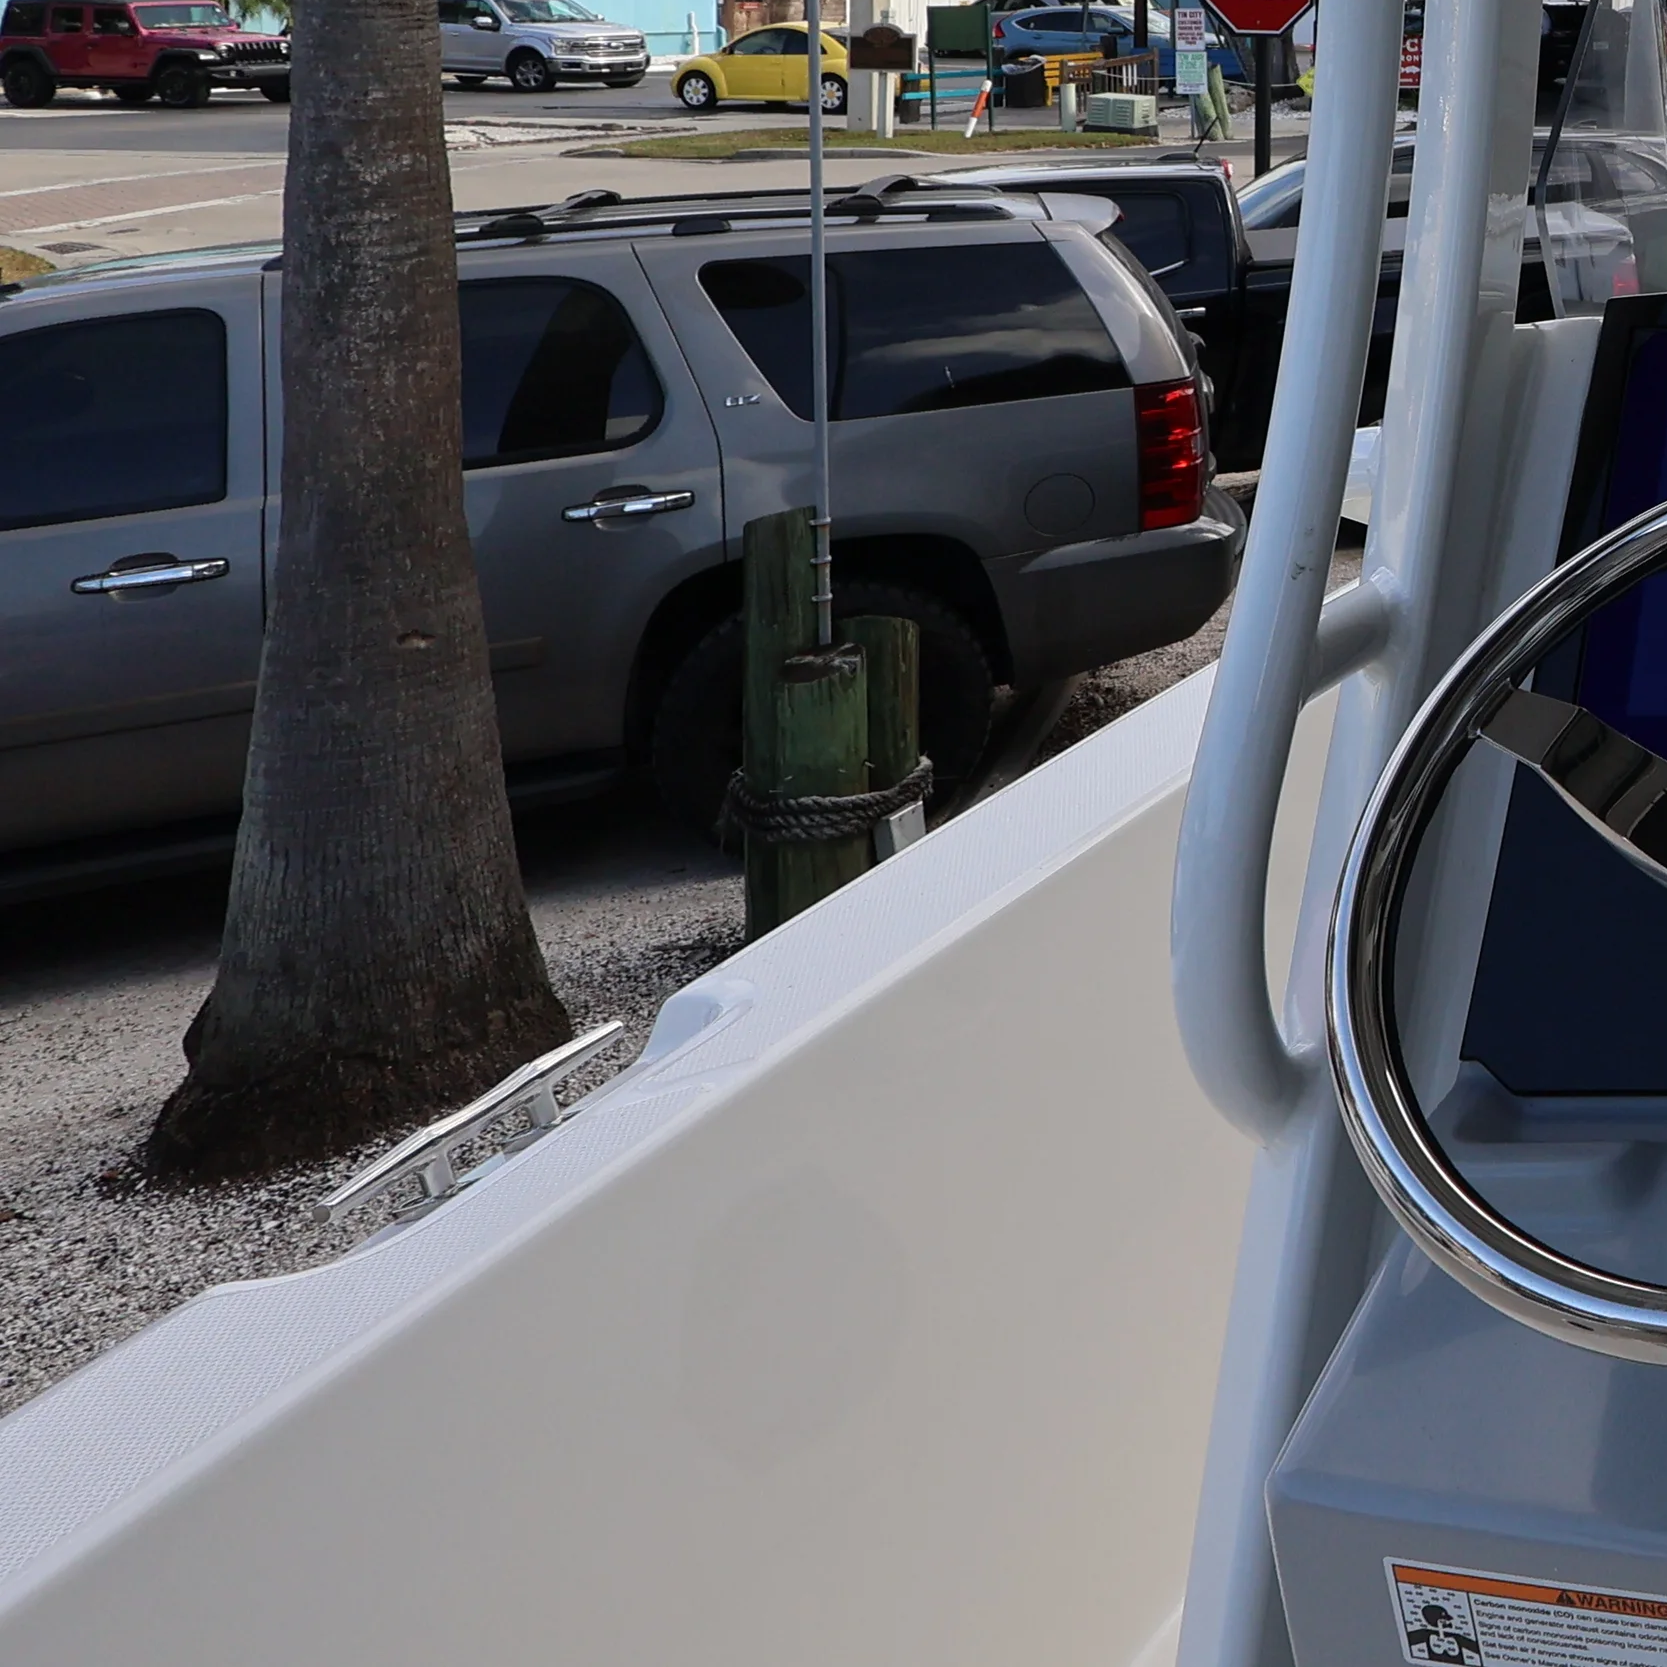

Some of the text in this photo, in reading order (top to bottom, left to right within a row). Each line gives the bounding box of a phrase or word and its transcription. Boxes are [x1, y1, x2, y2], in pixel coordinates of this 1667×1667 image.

[725, 393, 761, 407] LTZ
[1474, 1599, 1506, 1609] Carbon
[1508, 1604, 1551, 1615] monoxide
[1553, 1609, 1574, 1620] (CO)
[1594, 1616, 1619, 1625] cause
[1620, 1619, 1642, 1629] brain
[1476, 1610, 1505, 1620] Engine
[1507, 1615, 1522, 1623] and
[1524, 1618, 1564, 1629] generator
[1566, 1623, 1599, 1633] exhaust
[1600, 1628, 1636, 1638] contains
[1478, 1621, 1501, 1630] Signs
[1512, 1627, 1541, 1636] carbon
[1543, 1631, 1583, 1641] monoxide
[1585, 1636, 1626, 1649] poisoning
[1627, 1642, 1657, 1652] include
[1480, 1630, 1496, 1638] and
[1497, 1632, 1515, 1641] lack
[1482, 1640, 1497, 1648] Get
[1498, 1642, 1518, 1651] fresh
[1538, 1649, 1567, 1659] anyone
[1568, 1653, 1595, 1662] shows
[1596, 1656, 1618, 1666] signs
[1484, 1651, 1501, 1660] See
[1502, 1654, 1536, 1665] Owner's
